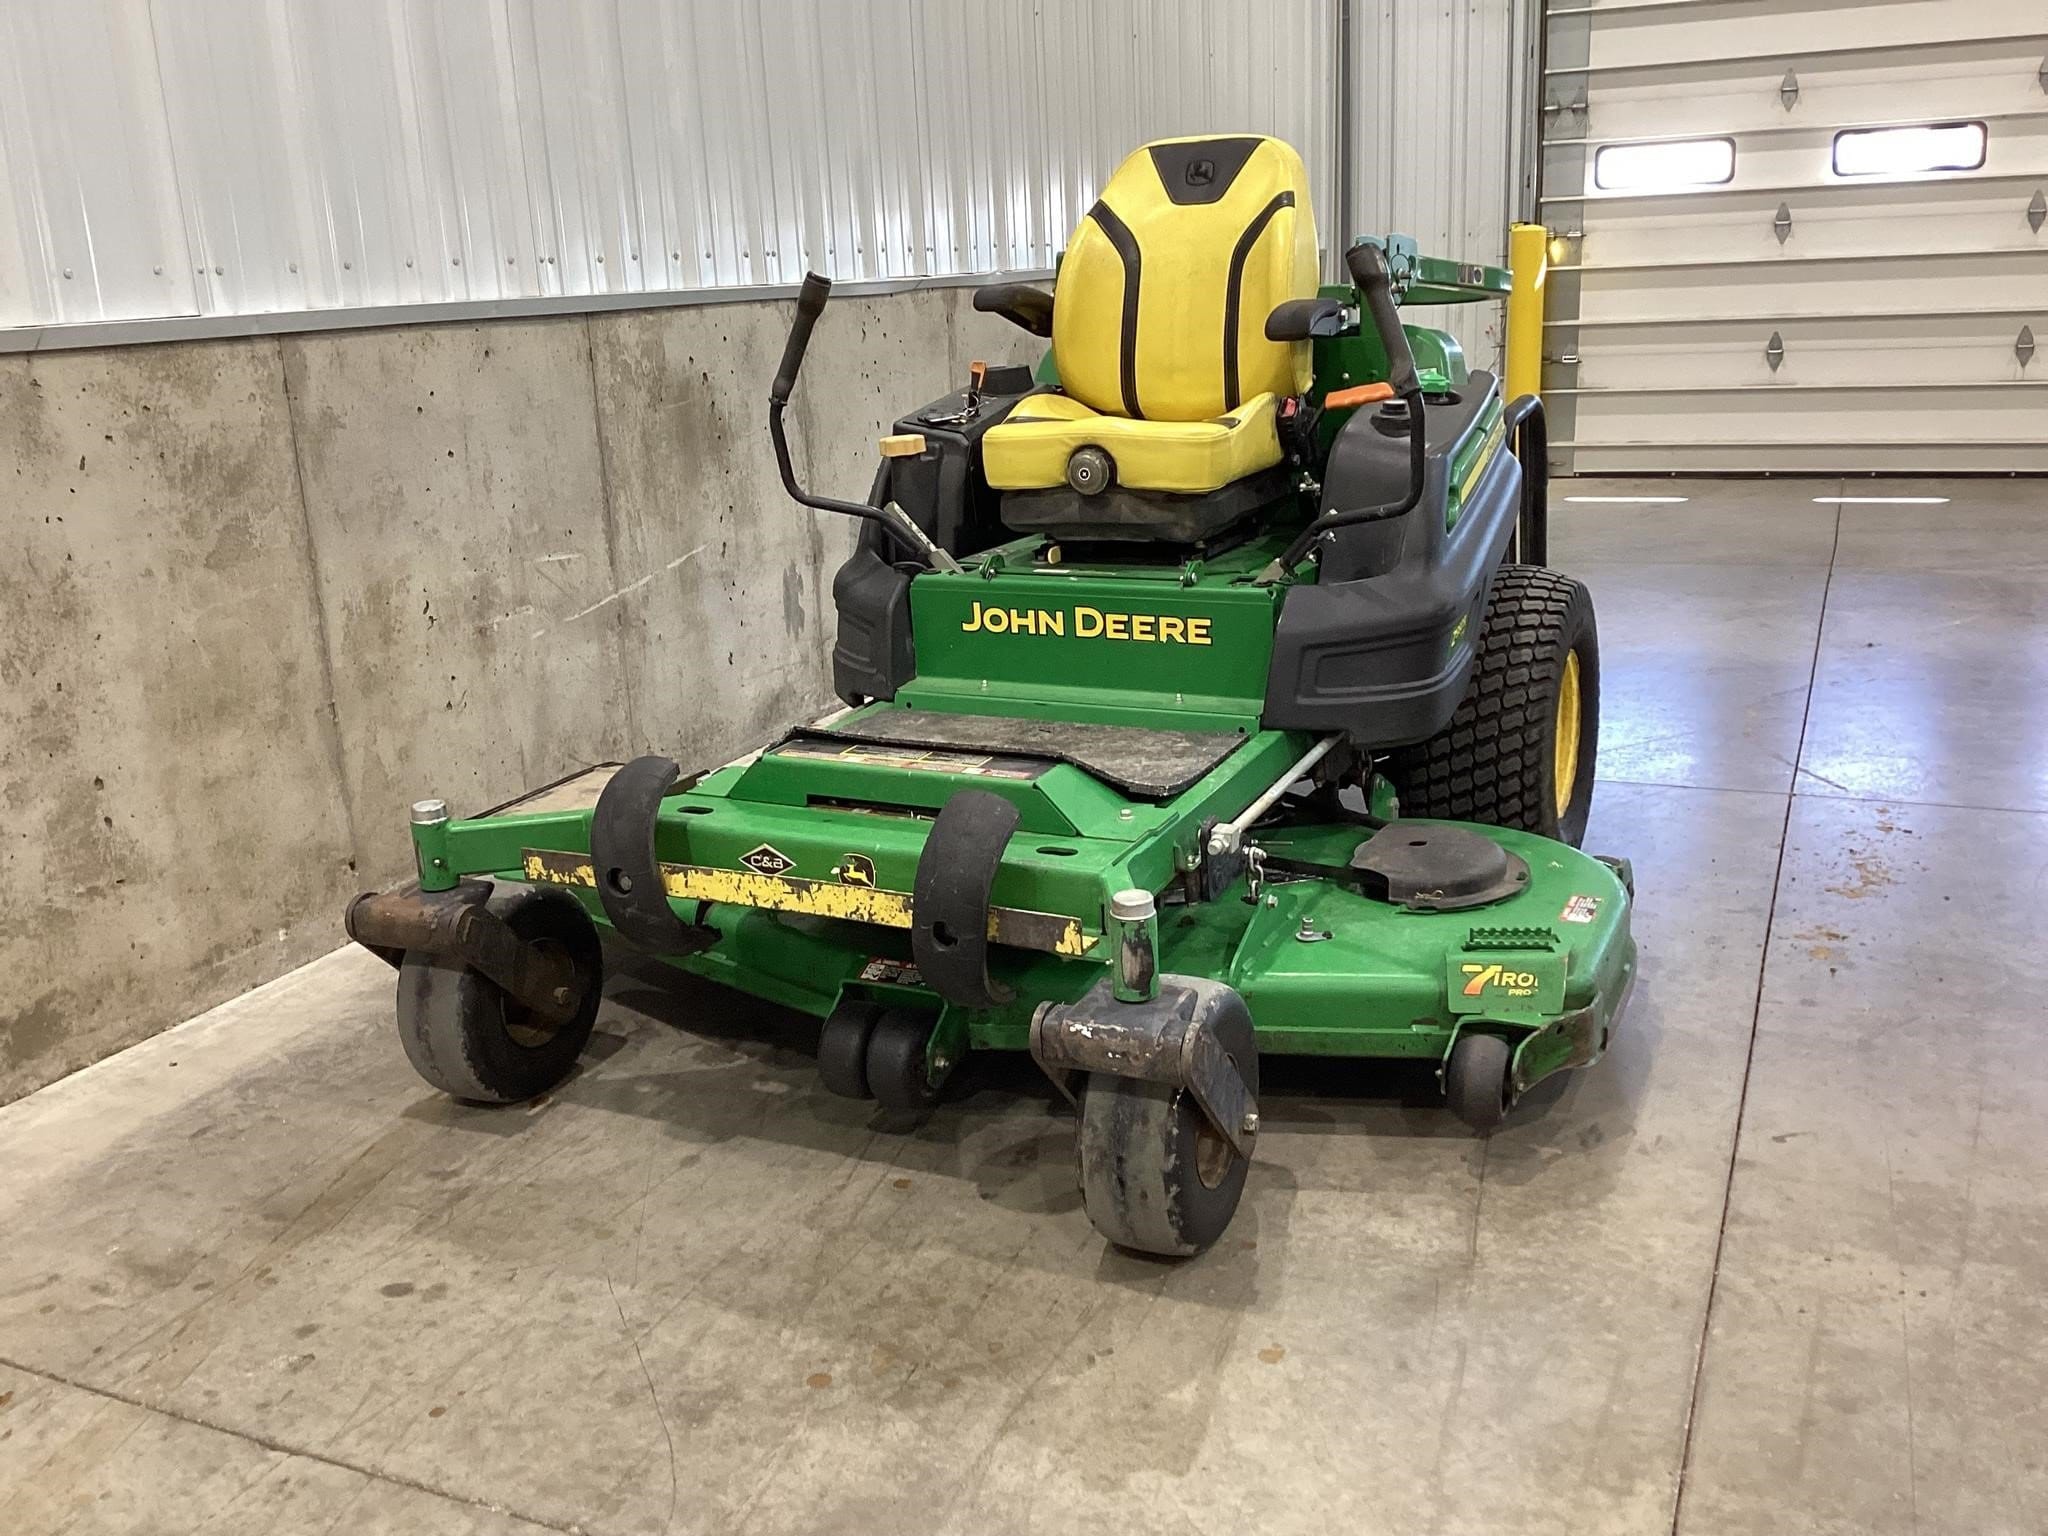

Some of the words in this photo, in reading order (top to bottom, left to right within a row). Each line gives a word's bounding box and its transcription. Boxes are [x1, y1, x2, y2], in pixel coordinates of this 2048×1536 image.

[961, 602, 1064, 636] JOHN
[1074, 606, 1212, 645] DEERE
[750, 855, 783, 869] C&B
